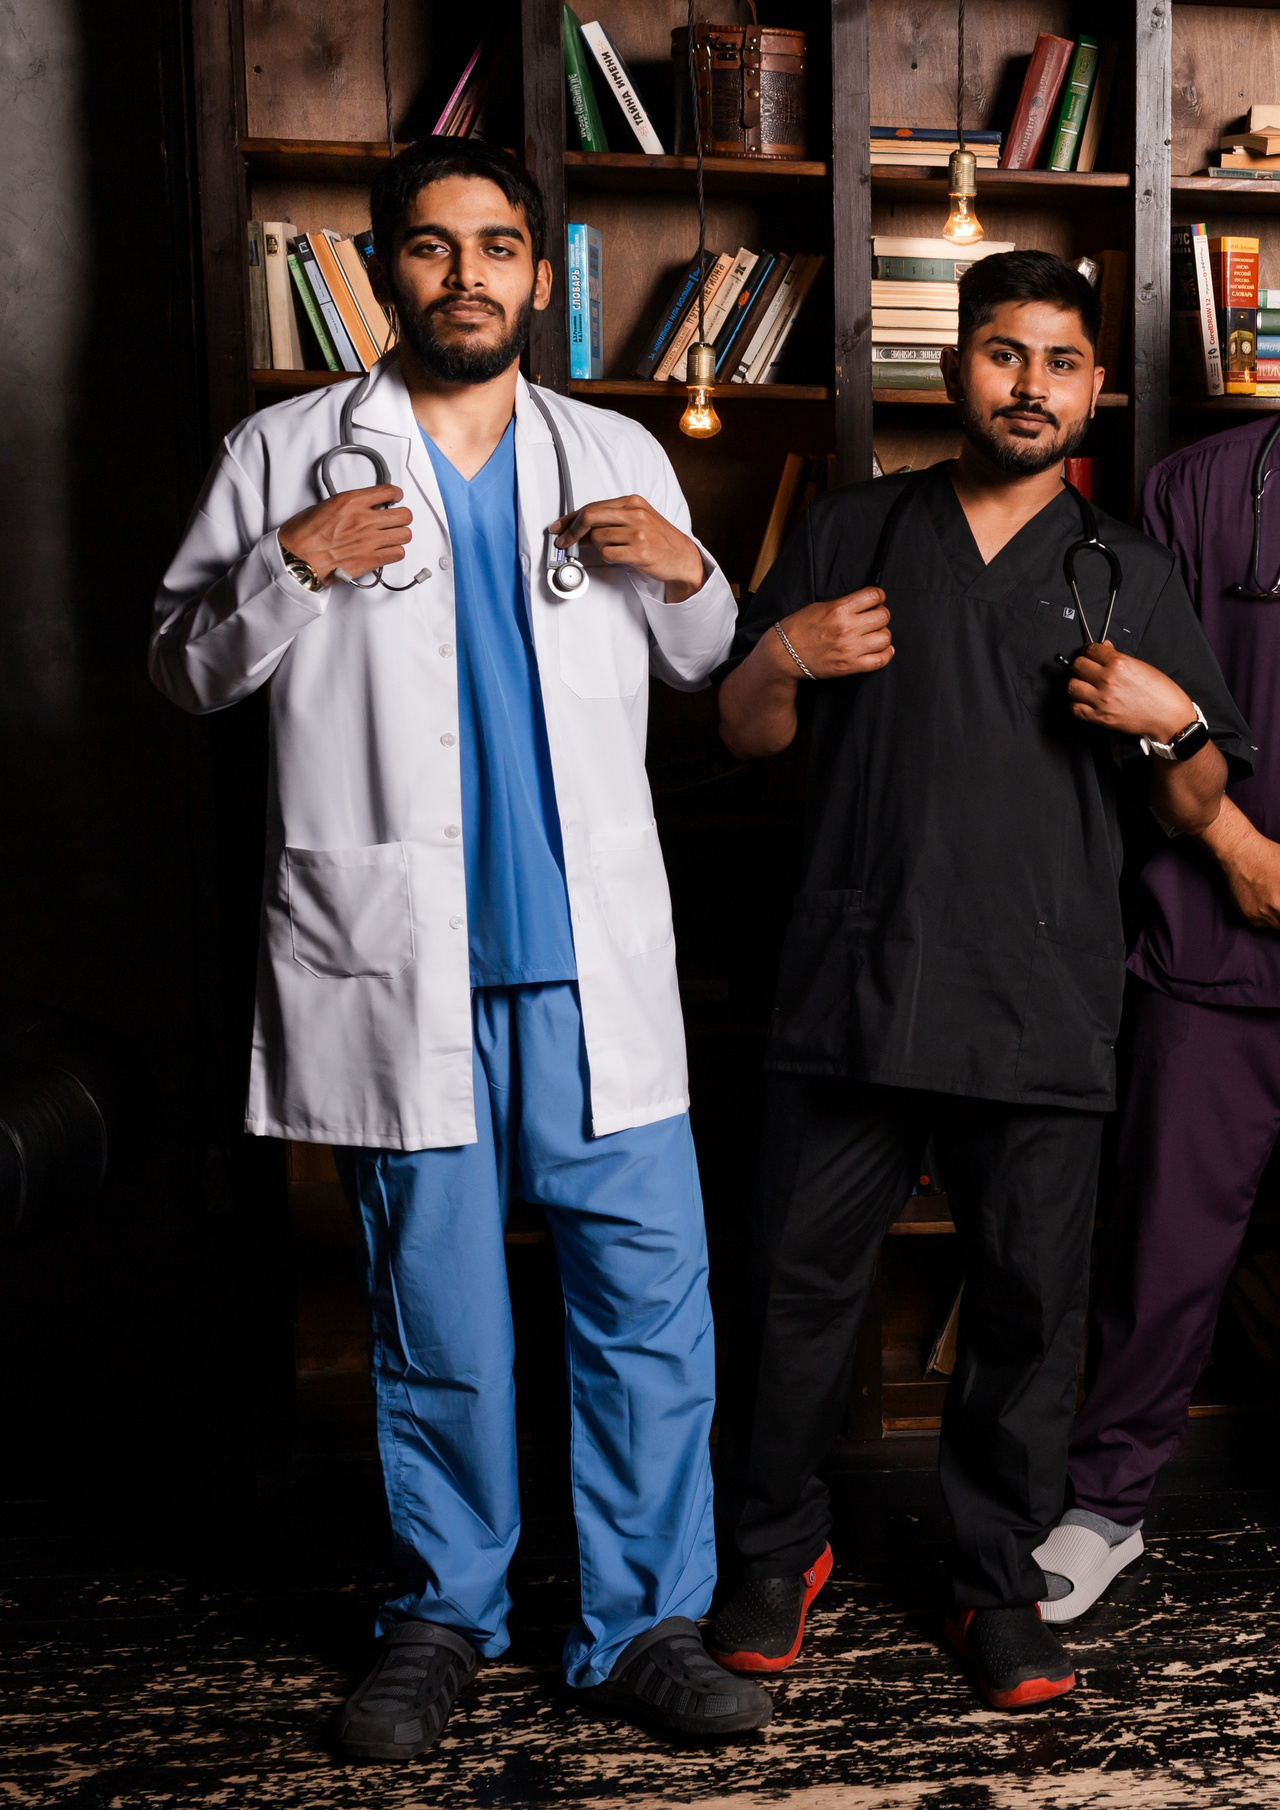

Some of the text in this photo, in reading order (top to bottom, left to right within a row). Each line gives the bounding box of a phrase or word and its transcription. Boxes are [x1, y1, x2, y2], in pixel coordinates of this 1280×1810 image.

[600, 50, 645, 126] ТАЙНА ИМЕНИ
[1016, 112, 1038, 164] АНТОНИНА
[571, 268, 582, 311] СЛОВАРЬ
[1231, 290, 1253, 298] СЛОВАРЬ
[647, 279, 695, 362] ЗА МИЛЛИОН ИЛИ БОЛЬШЕ
[1205, 298, 1216, 345] CorelDRAW 12
